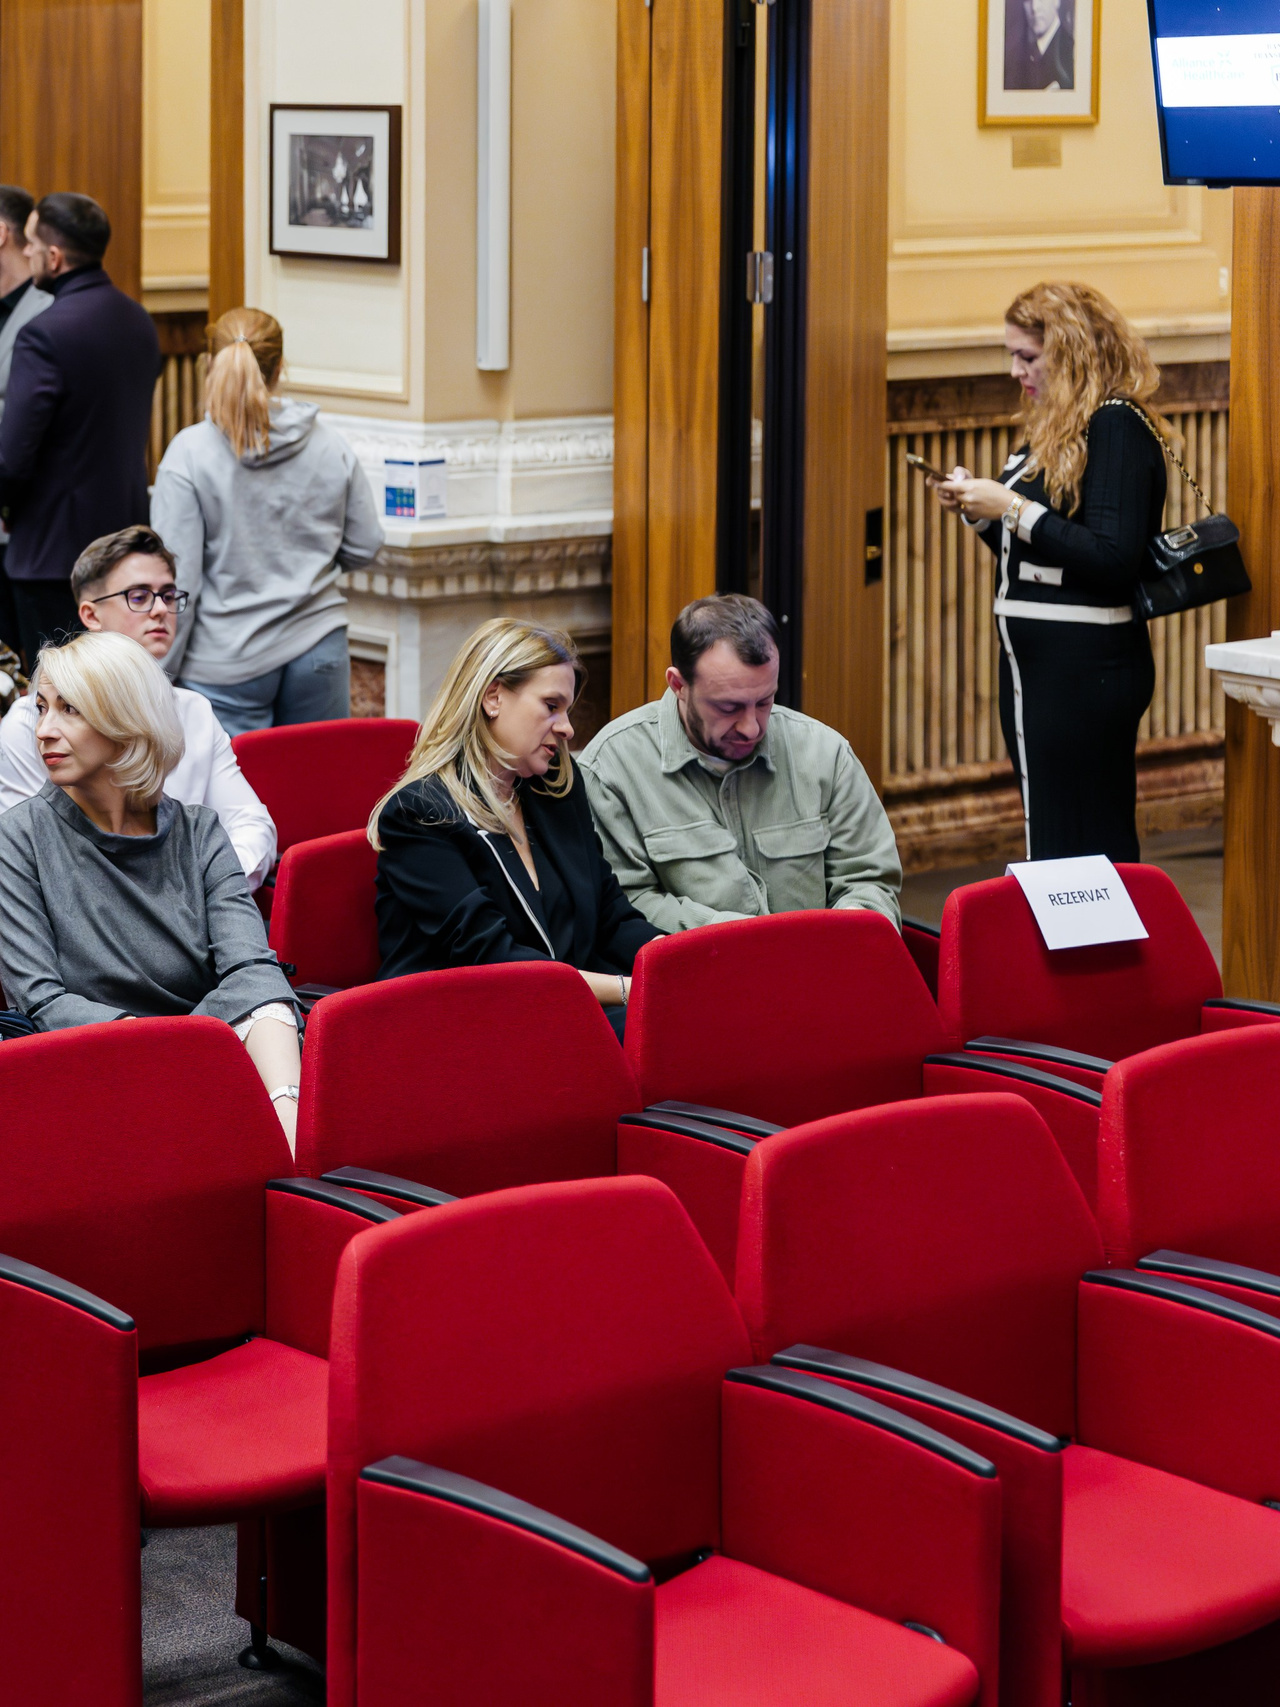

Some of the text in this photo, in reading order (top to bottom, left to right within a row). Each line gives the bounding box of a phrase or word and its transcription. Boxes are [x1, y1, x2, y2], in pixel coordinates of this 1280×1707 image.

[1172, 57, 1215, 69] Alliance
[1183, 69, 1245, 81] Healthcare
[1048, 888, 1111, 906] REZERVAT
